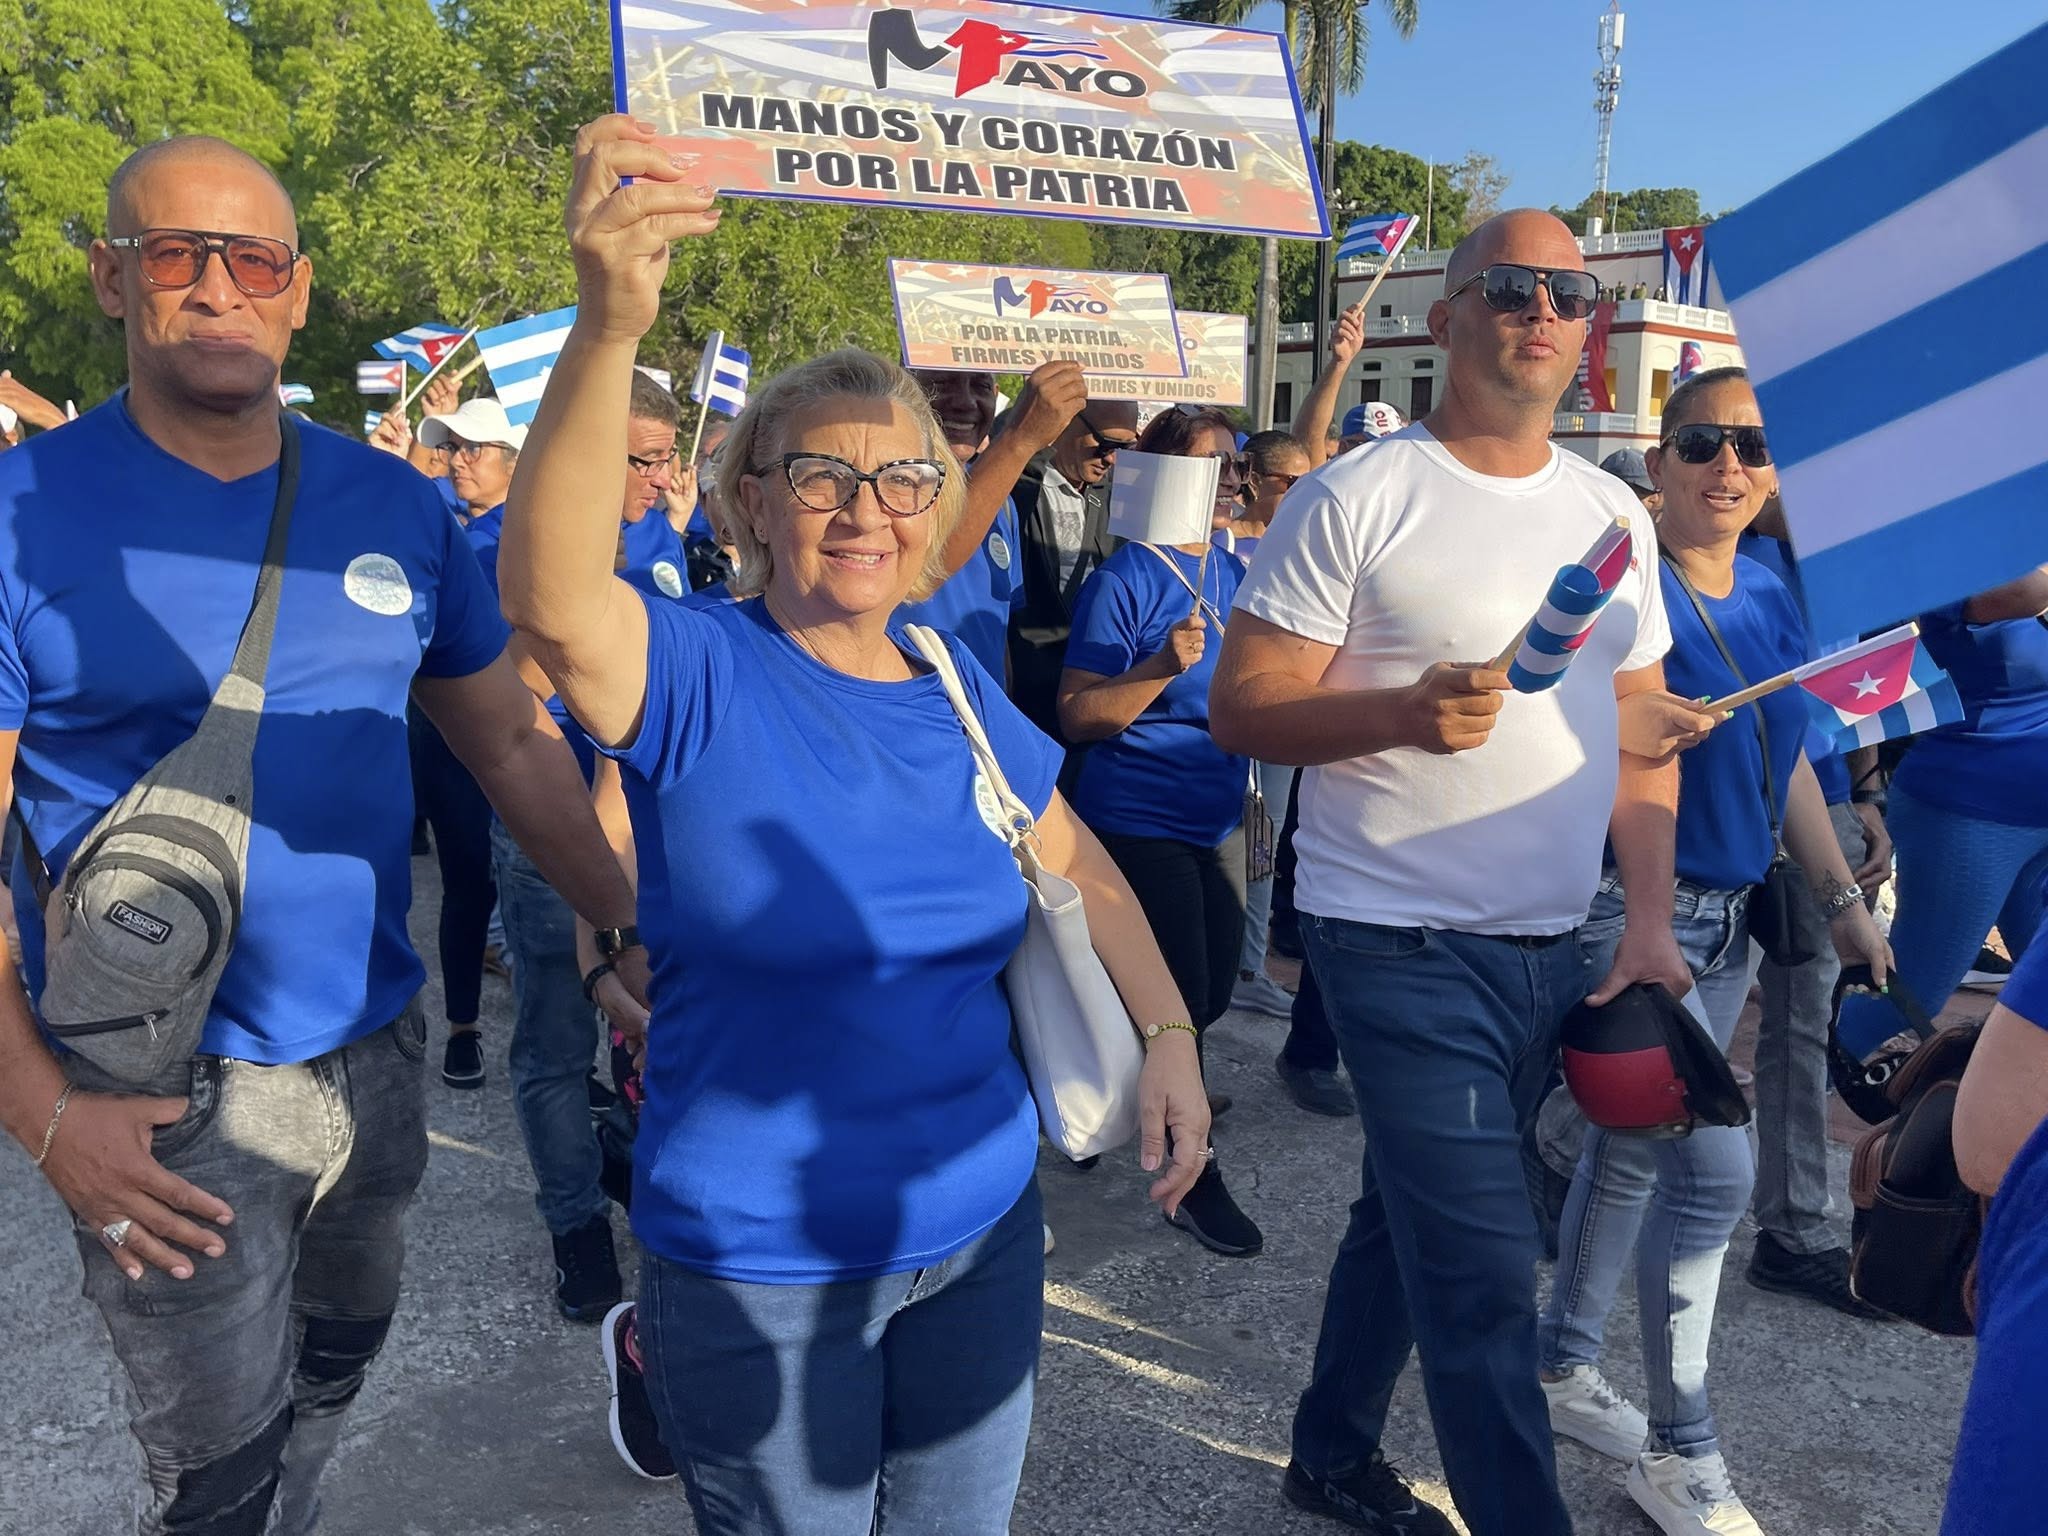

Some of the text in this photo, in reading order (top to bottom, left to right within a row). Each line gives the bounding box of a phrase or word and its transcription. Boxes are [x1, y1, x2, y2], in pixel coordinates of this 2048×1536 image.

[701, 92, 1237, 171] MANOS Y CORAZÓN
[775, 148, 1191, 213] POR LA PATRIA
[961, 324, 1127, 347] POR LA PATRIA,
[951, 346, 1144, 369] FIRMES Y UNIDOS
[1085, 378, 1216, 398] IRMES Y UNIDOS
